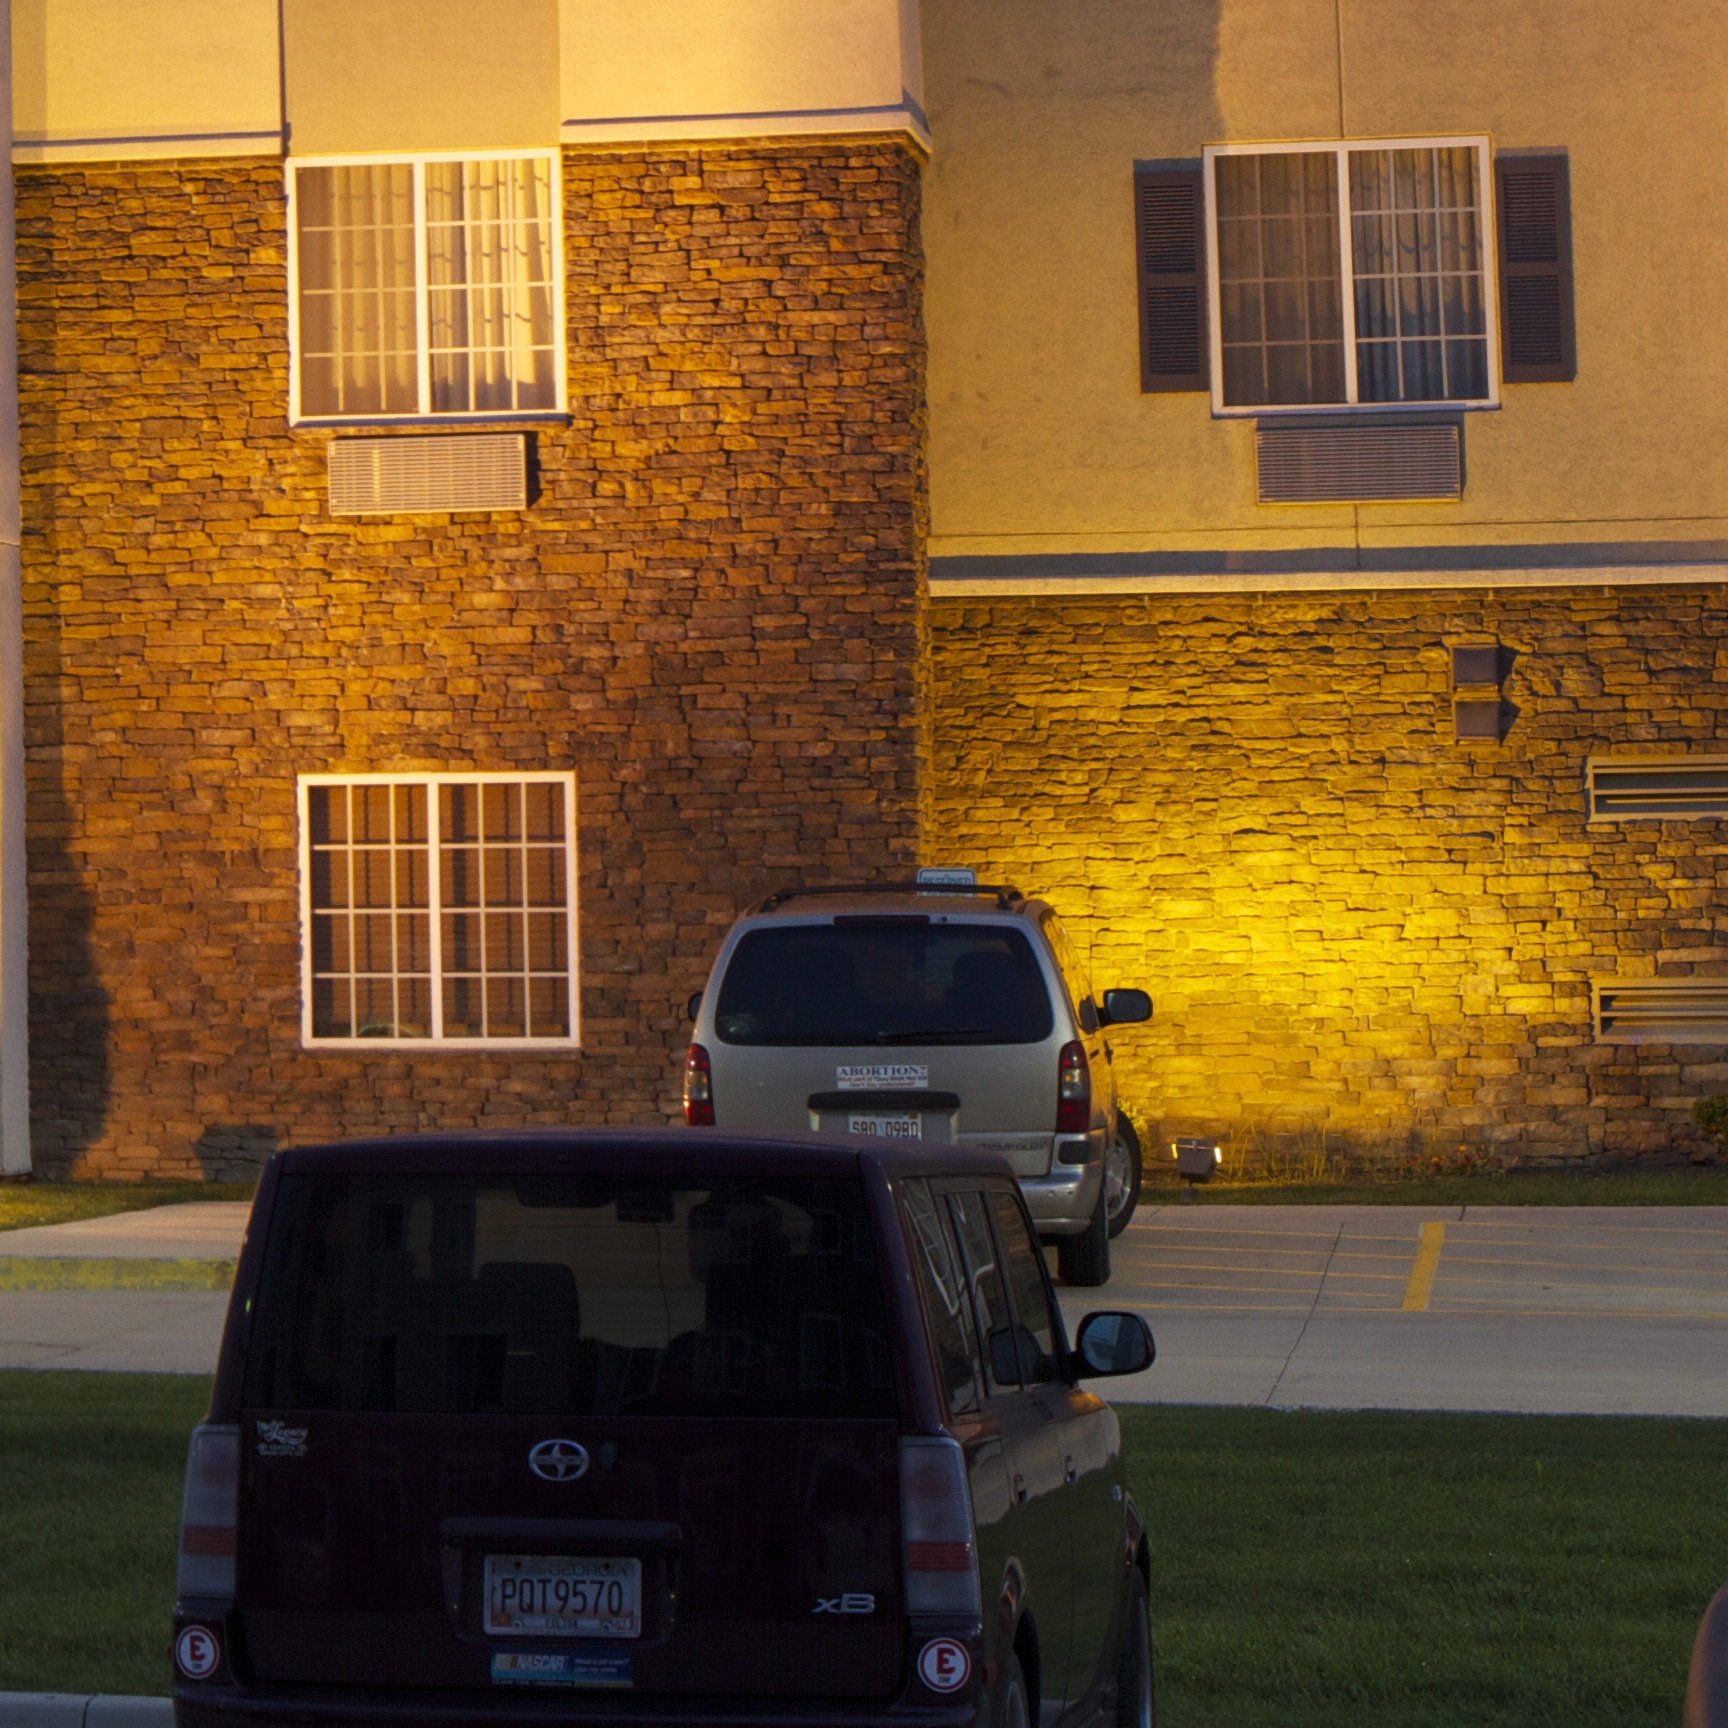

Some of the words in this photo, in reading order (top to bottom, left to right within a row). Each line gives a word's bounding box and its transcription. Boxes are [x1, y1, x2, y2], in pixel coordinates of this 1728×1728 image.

[840, 1065, 926, 1077] ABORTION?
[547, 1562, 629, 1578] GEORGIA
[501, 1577, 624, 1616] PQT9570
[811, 1593, 875, 1615] xB
[190, 1635, 206, 1661] E
[517, 1655, 566, 1672] NASCAR
[936, 1647, 956, 1675] E
